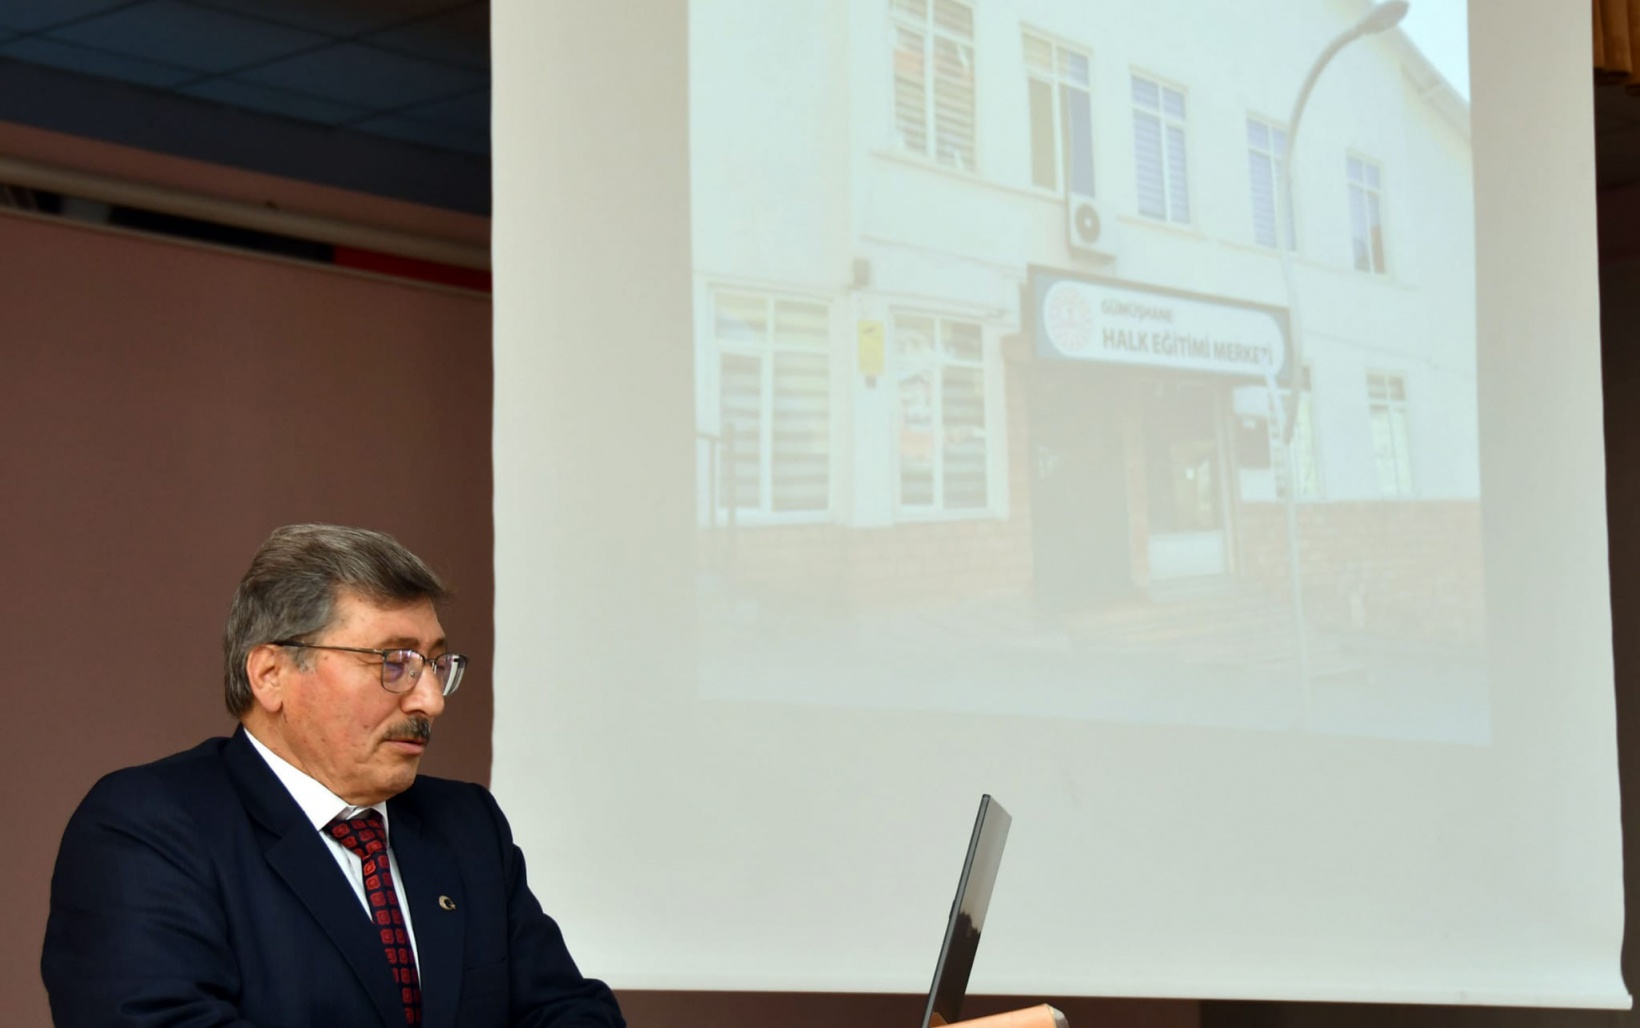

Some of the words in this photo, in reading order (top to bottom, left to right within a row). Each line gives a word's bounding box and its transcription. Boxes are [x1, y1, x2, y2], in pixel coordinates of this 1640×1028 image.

[1101, 299, 1173, 323] GÜMÜŞHANE
[1102, 327, 1149, 352] HALK
[1152, 330, 1211, 358] EĞİTİMİ
